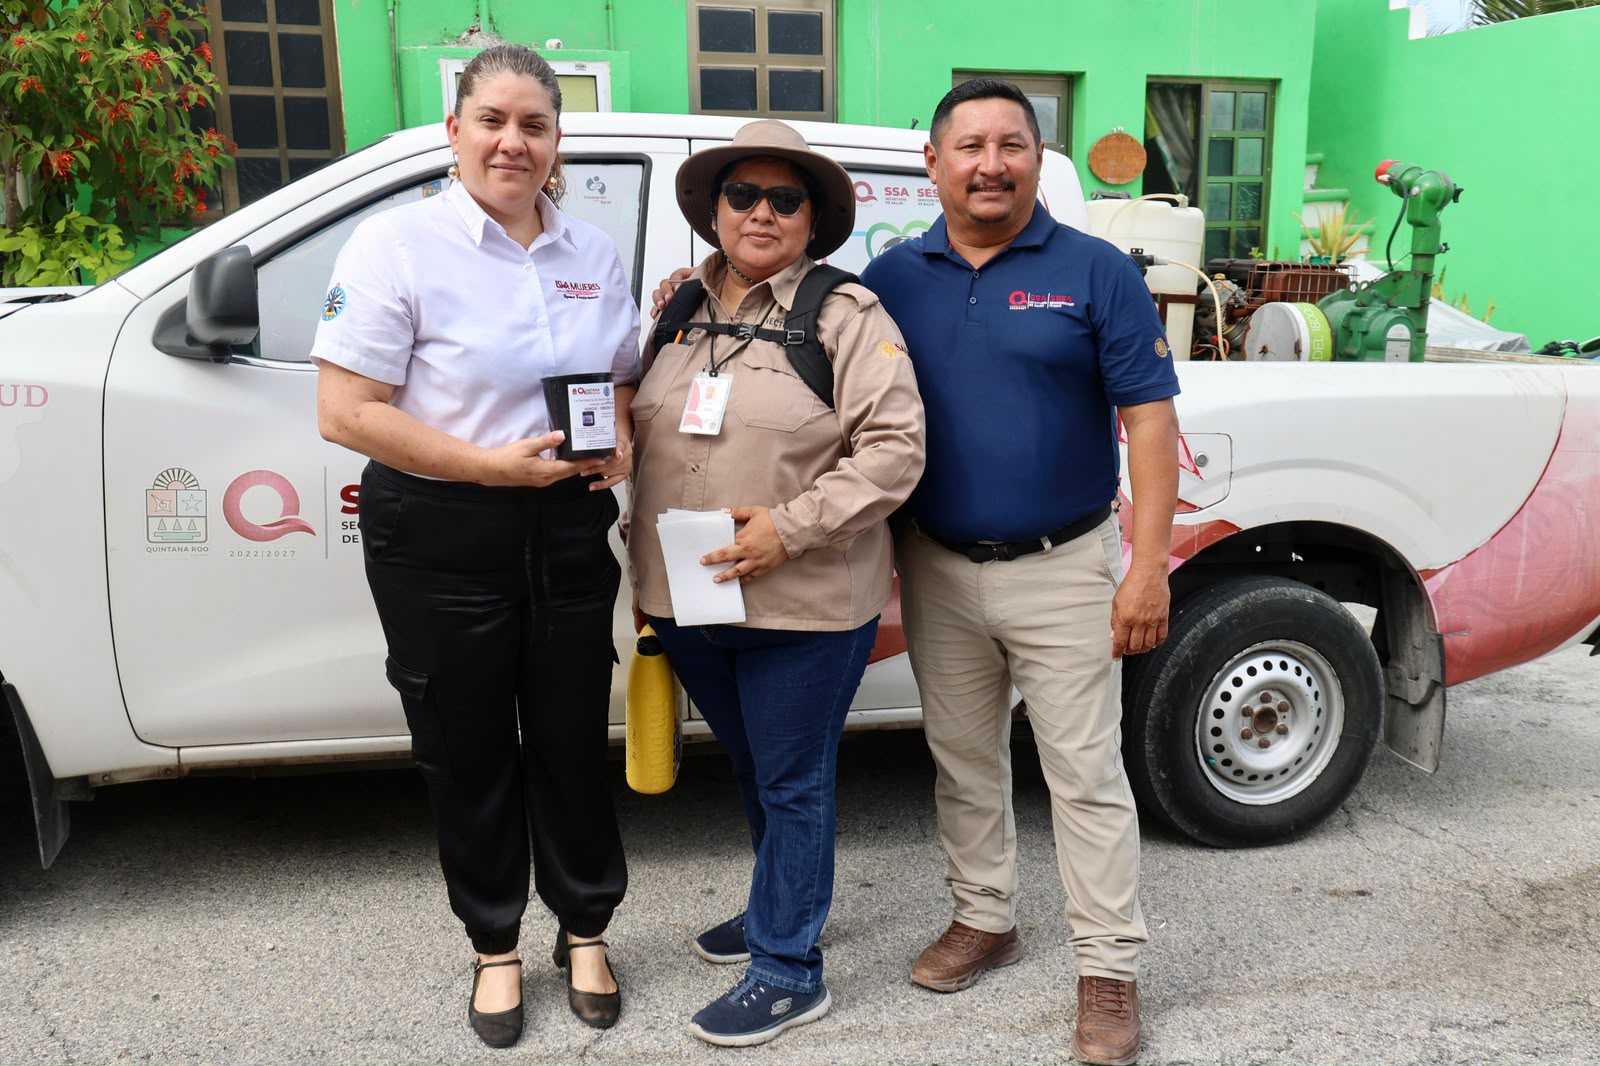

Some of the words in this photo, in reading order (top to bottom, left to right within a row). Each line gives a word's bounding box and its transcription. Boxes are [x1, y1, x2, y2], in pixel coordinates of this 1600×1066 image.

[884, 187, 910, 197] SSA
[1030, 294, 1047, 302] SSA
[1312, 335, 1325, 361] DEL
[342, 534, 360, 543] DE
